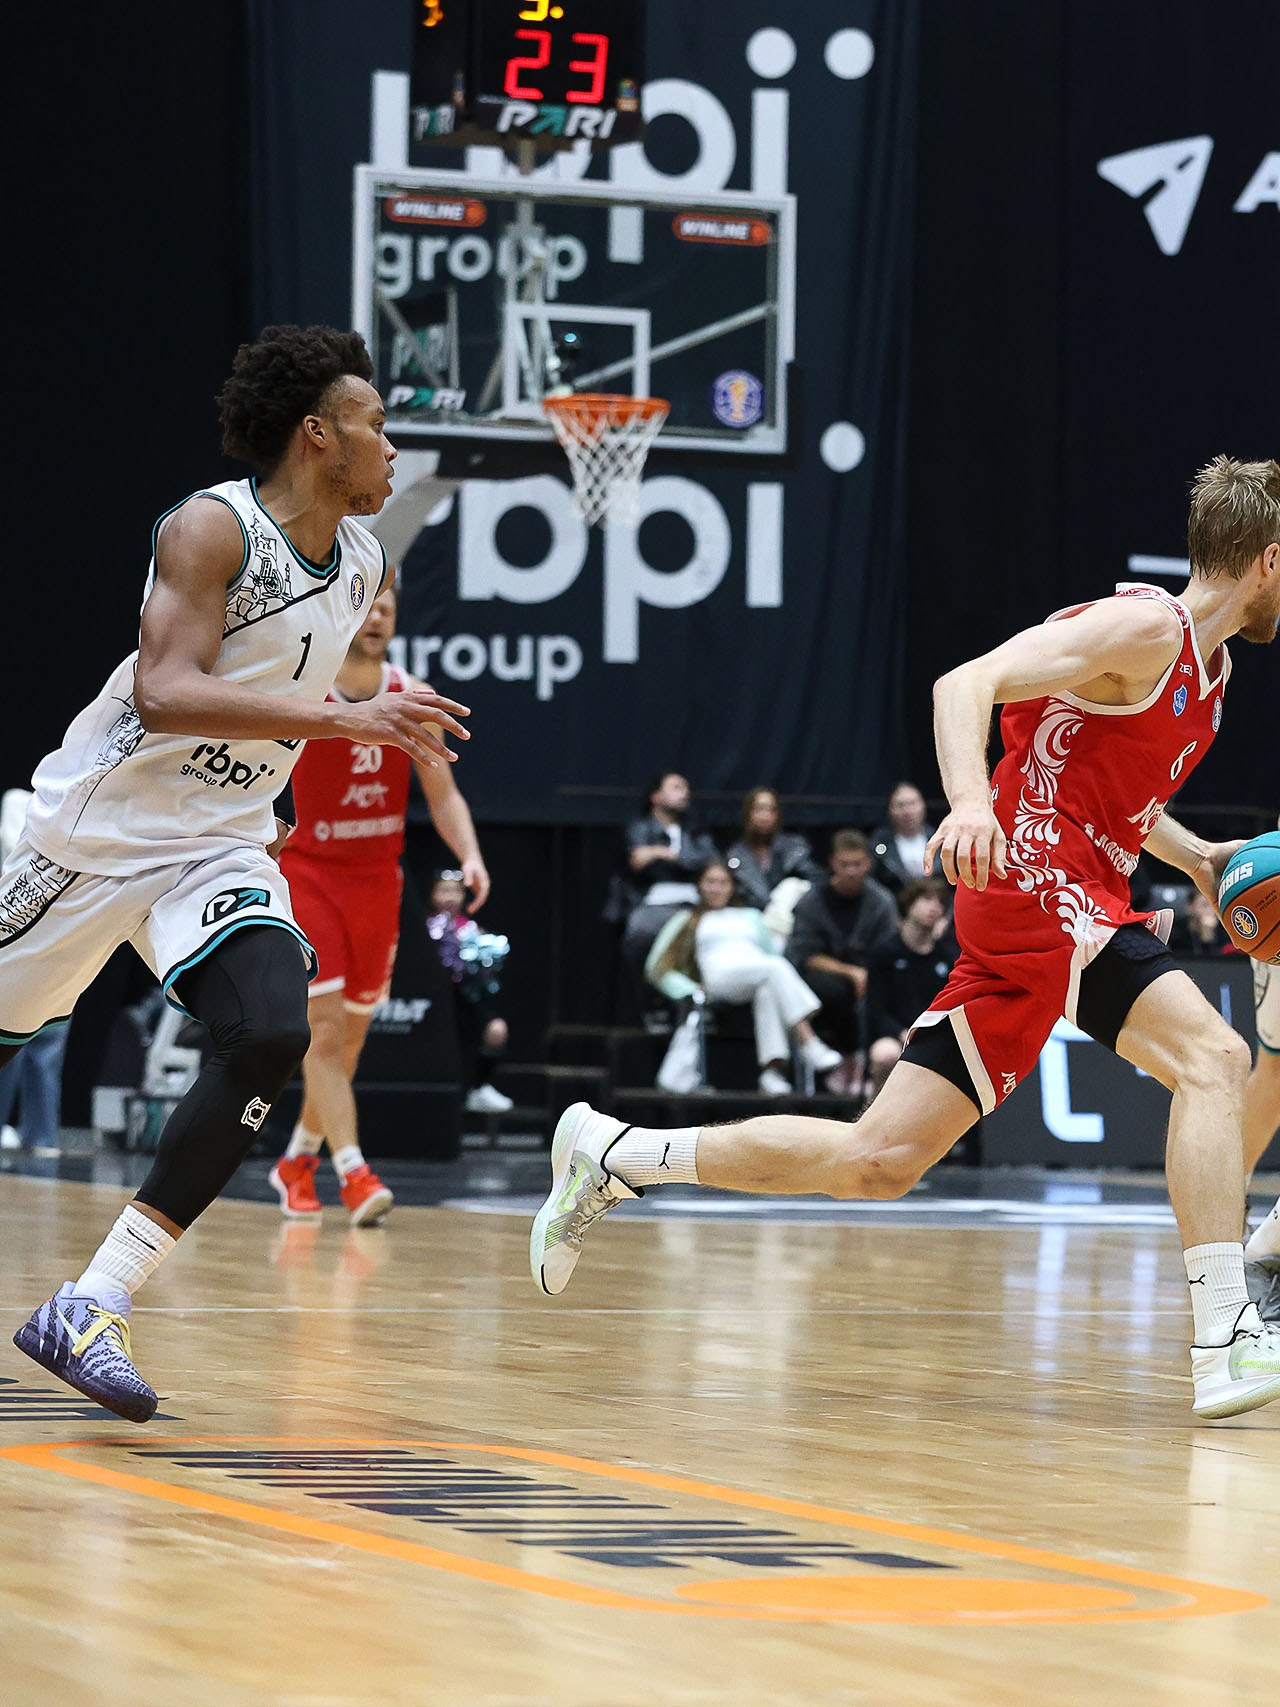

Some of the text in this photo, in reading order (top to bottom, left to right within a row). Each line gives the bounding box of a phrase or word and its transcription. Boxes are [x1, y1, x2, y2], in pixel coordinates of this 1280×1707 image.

[503, 28, 609, 104] 23
[496, 102, 617, 139] PARI
[291, 632, 313, 681] 1
[180, 764, 218, 787] group
[350, 744, 383, 775] 20
